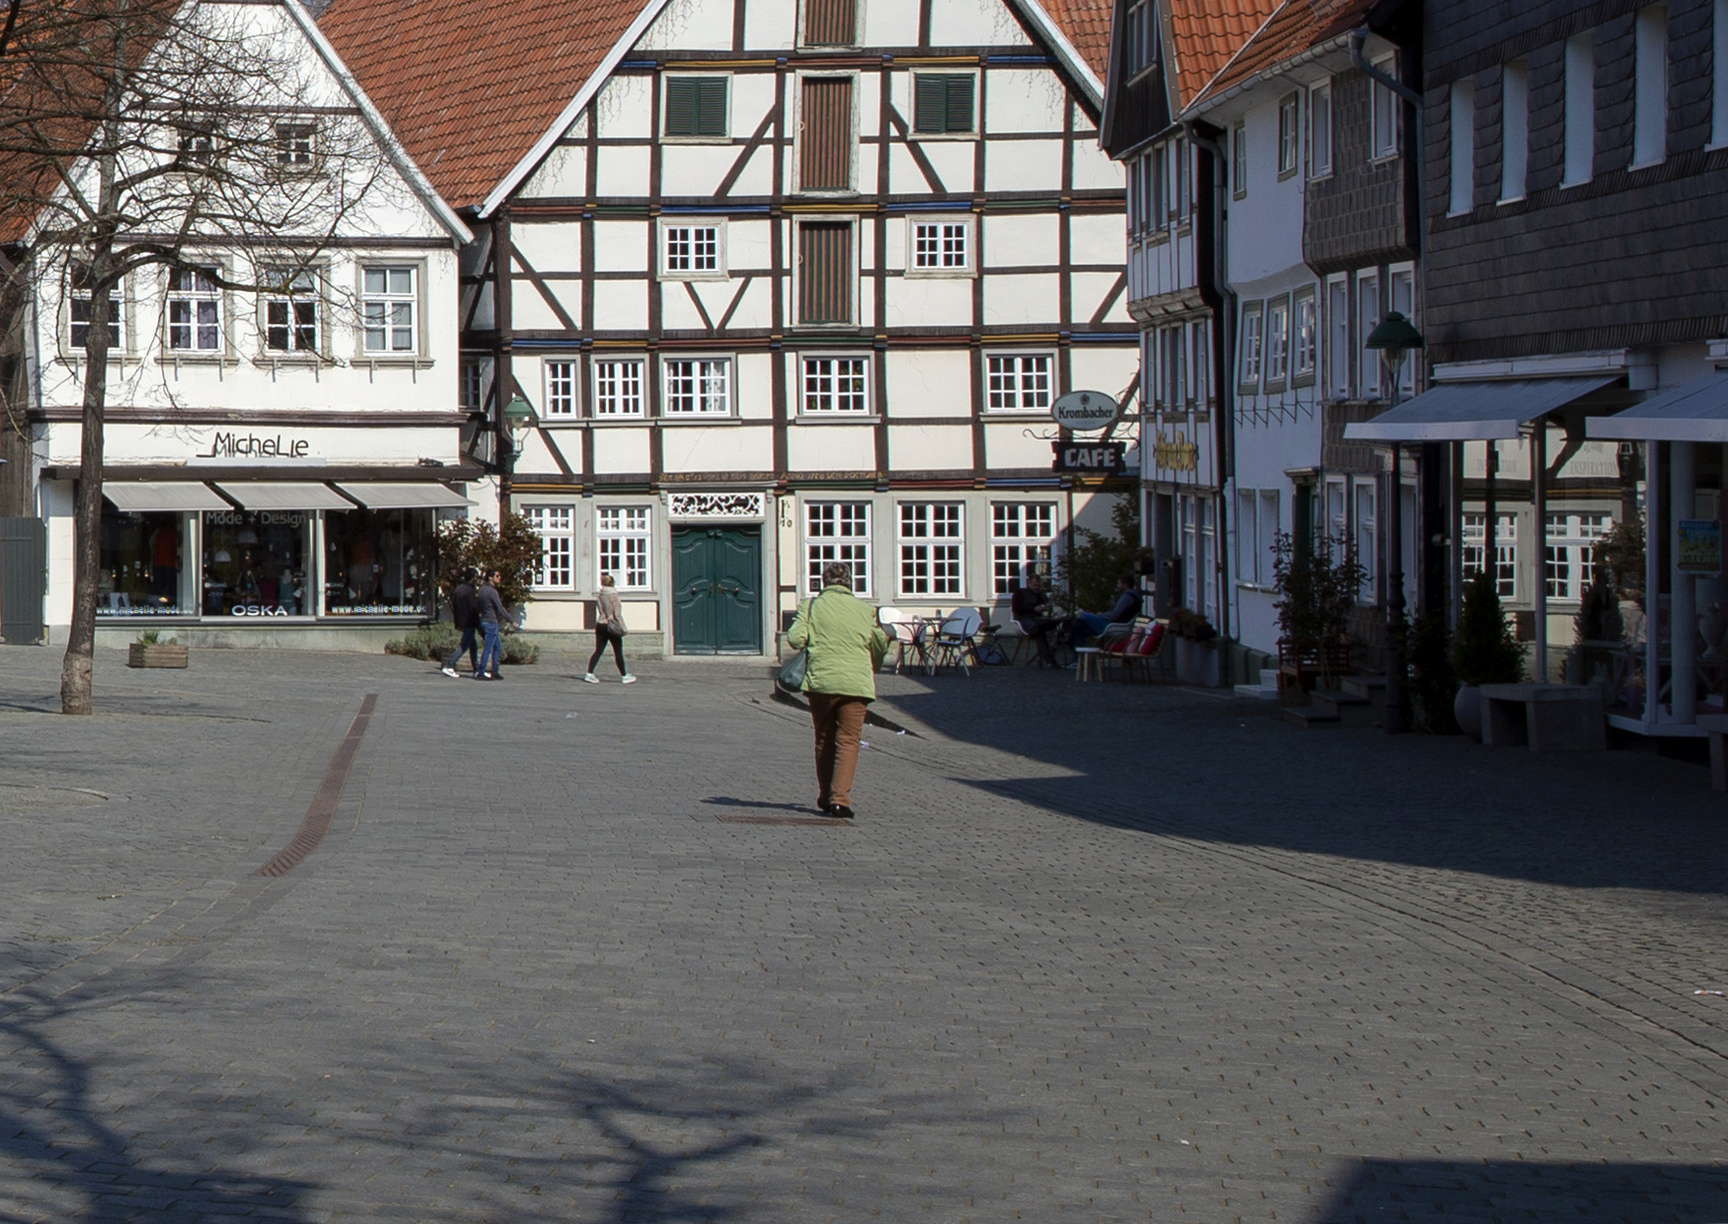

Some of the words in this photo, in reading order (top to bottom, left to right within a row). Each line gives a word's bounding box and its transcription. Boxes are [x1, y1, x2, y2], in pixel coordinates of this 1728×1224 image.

[1058, 406, 1114, 419] Krombacher
[1064, 447, 1116, 467] CAFE
[205, 511, 243, 524] Mode
[261, 511, 307, 528] Design
[231, 605, 288, 616] OSKA
